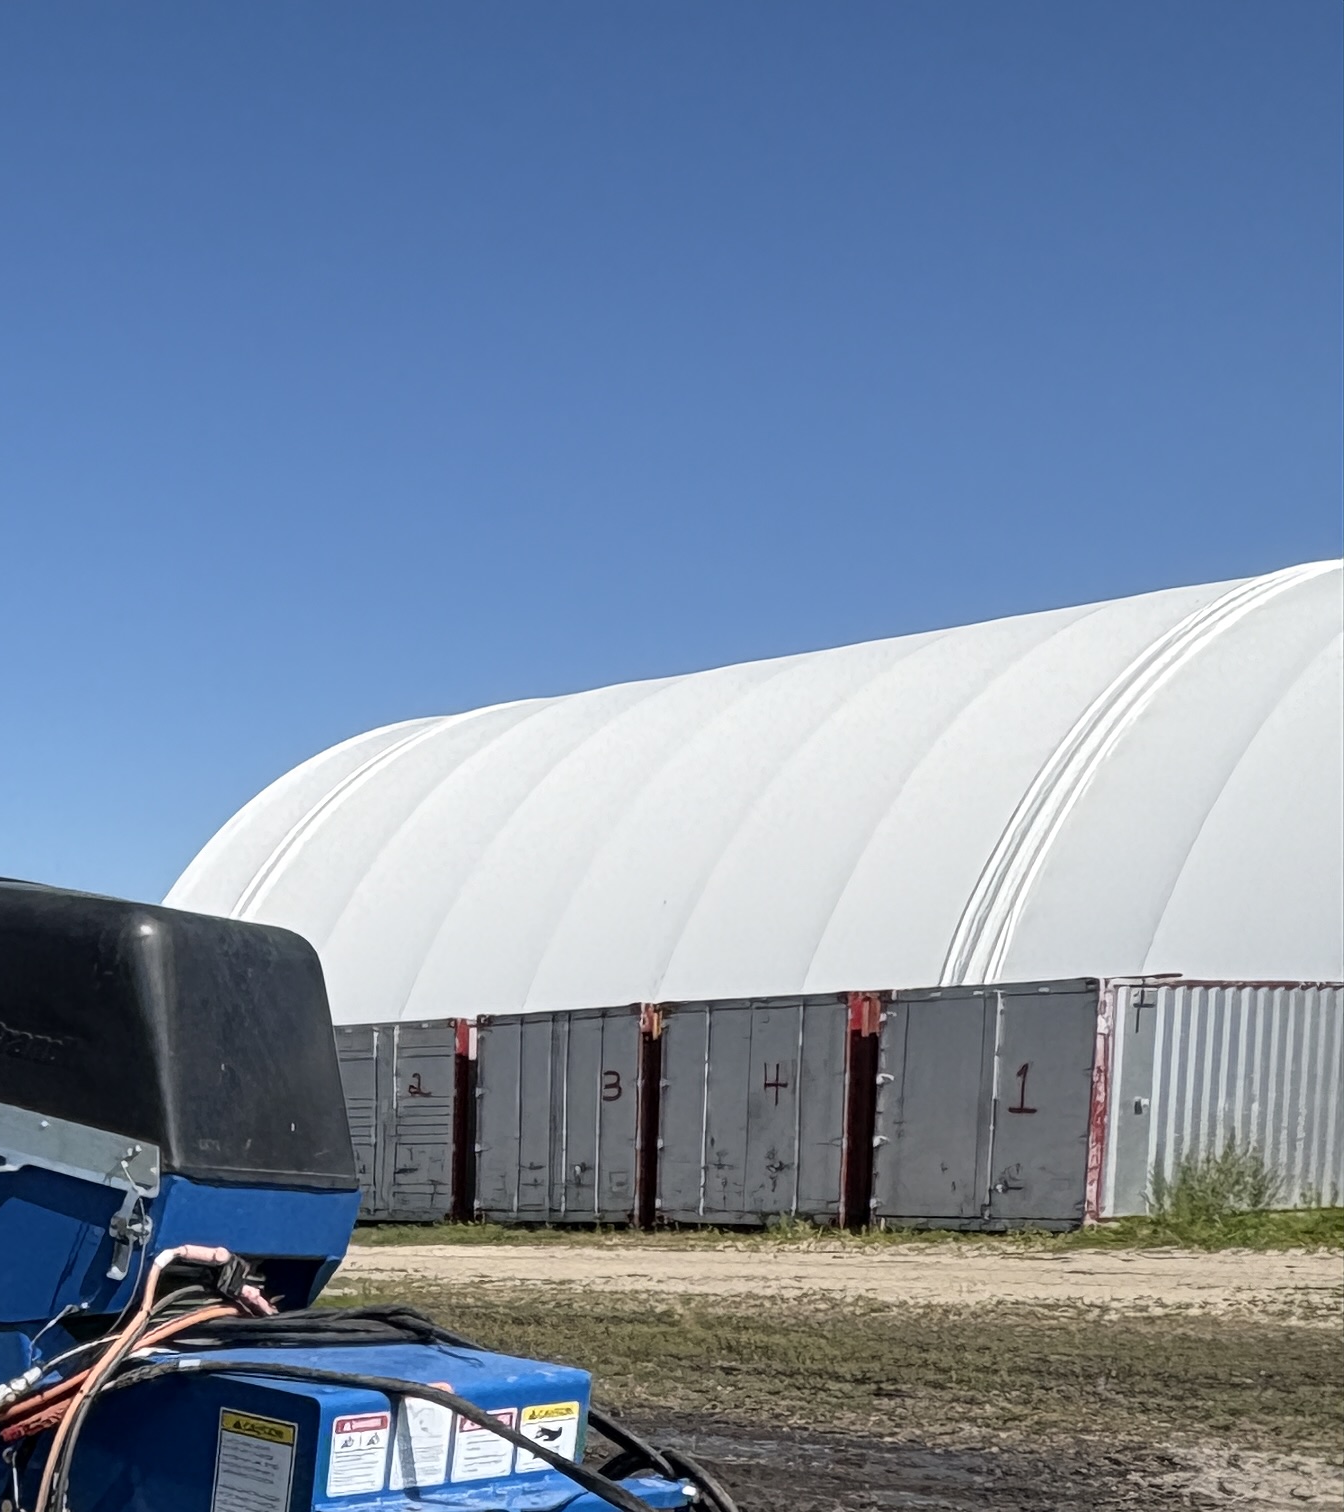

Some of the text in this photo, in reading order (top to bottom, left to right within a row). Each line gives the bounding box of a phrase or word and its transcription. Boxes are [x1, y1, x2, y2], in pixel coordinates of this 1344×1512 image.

[408, 1072, 432, 1097] 2
[602, 1070, 622, 1101] 3
[764, 1062, 788, 1106] 4
[1008, 1062, 1037, 1114] 1
